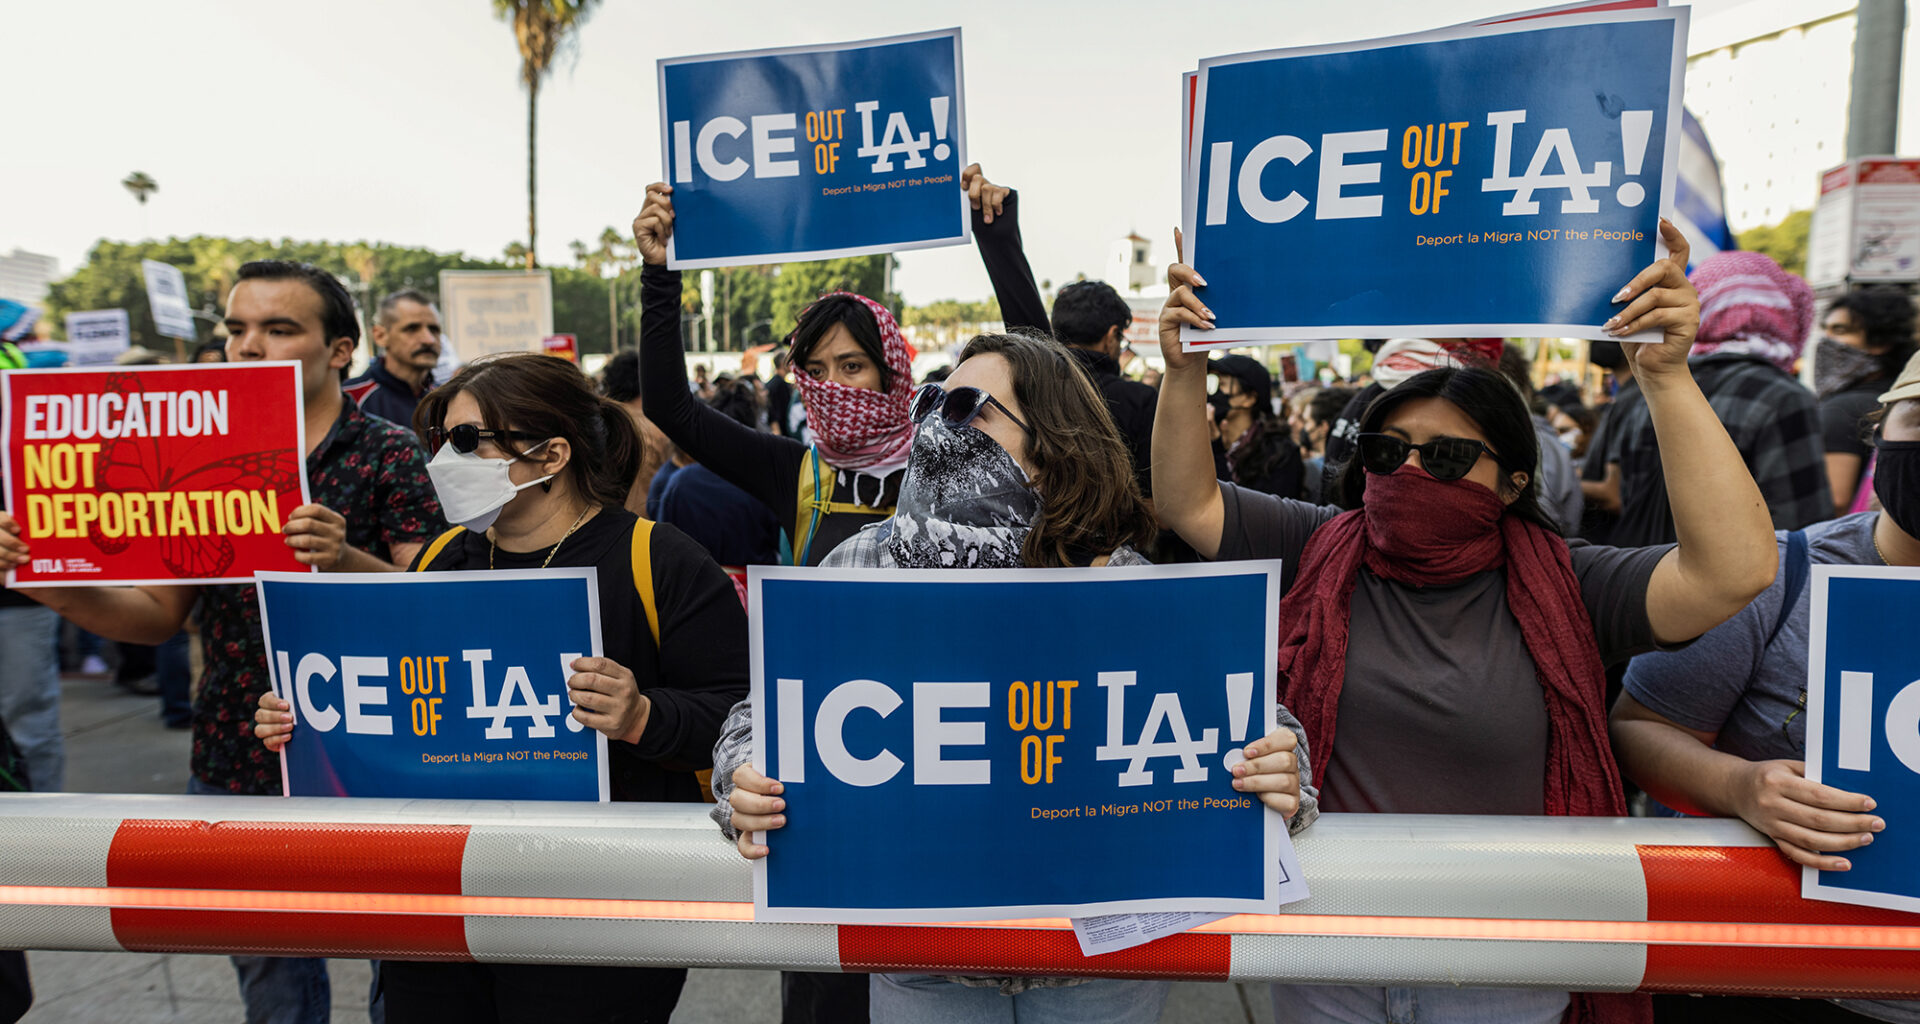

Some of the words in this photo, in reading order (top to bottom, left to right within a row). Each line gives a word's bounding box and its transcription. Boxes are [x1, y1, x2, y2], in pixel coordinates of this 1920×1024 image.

[673, 113, 800, 184] ICE
[805, 109, 846, 142] OUT
[855, 96, 951, 174] LA!
[1402, 121, 1469, 169] OUT
[815, 143, 840, 175] OF
[1205, 128, 1389, 226] ICE
[1481, 109, 1653, 216] LA!
[822, 187, 851, 196] Deport
[854, 184, 861, 193] la
[862, 183, 886, 192] Migra
[888, 179, 906, 189] NOT
[908, 178, 922, 186] the
[924, 174, 953, 185] People
[1409, 170, 1452, 216] OF
[1416, 234, 1463, 247] Deport
[1468, 233, 1479, 243] la
[1484, 232, 1522, 244] Migra
[1527, 229, 1560, 241] NOT
[1565, 230, 1588, 241] the
[1593, 229, 1644, 242] People
[24, 390, 229, 440] EDUCATION
[24, 443, 100, 489] NOT
[26, 489, 281, 538] DEPORTATION
[32, 558, 64, 573] UTLA
[276, 650, 393, 735] ICE
[400, 656, 449, 694] OUT
[411, 698, 442, 736] OF
[1008, 680, 1079, 731] OUT
[1096, 670, 1254, 787] LA!
[776, 678, 991, 787] ICE
[422, 753, 459, 764] Deport
[462, 753, 471, 762] la
[474, 753, 503, 763] Migra
[506, 751, 530, 761] NOT
[533, 750, 551, 760] the
[553, 750, 588, 761] People
[1020, 735, 1065, 785] OF
[1031, 807, 1080, 820] Deport
[1085, 805, 1097, 817] la
[1101, 804, 1139, 817] Migra
[1143, 800, 1173, 813] NOT
[1178, 799, 1199, 811] the
[1203, 797, 1251, 810] People
